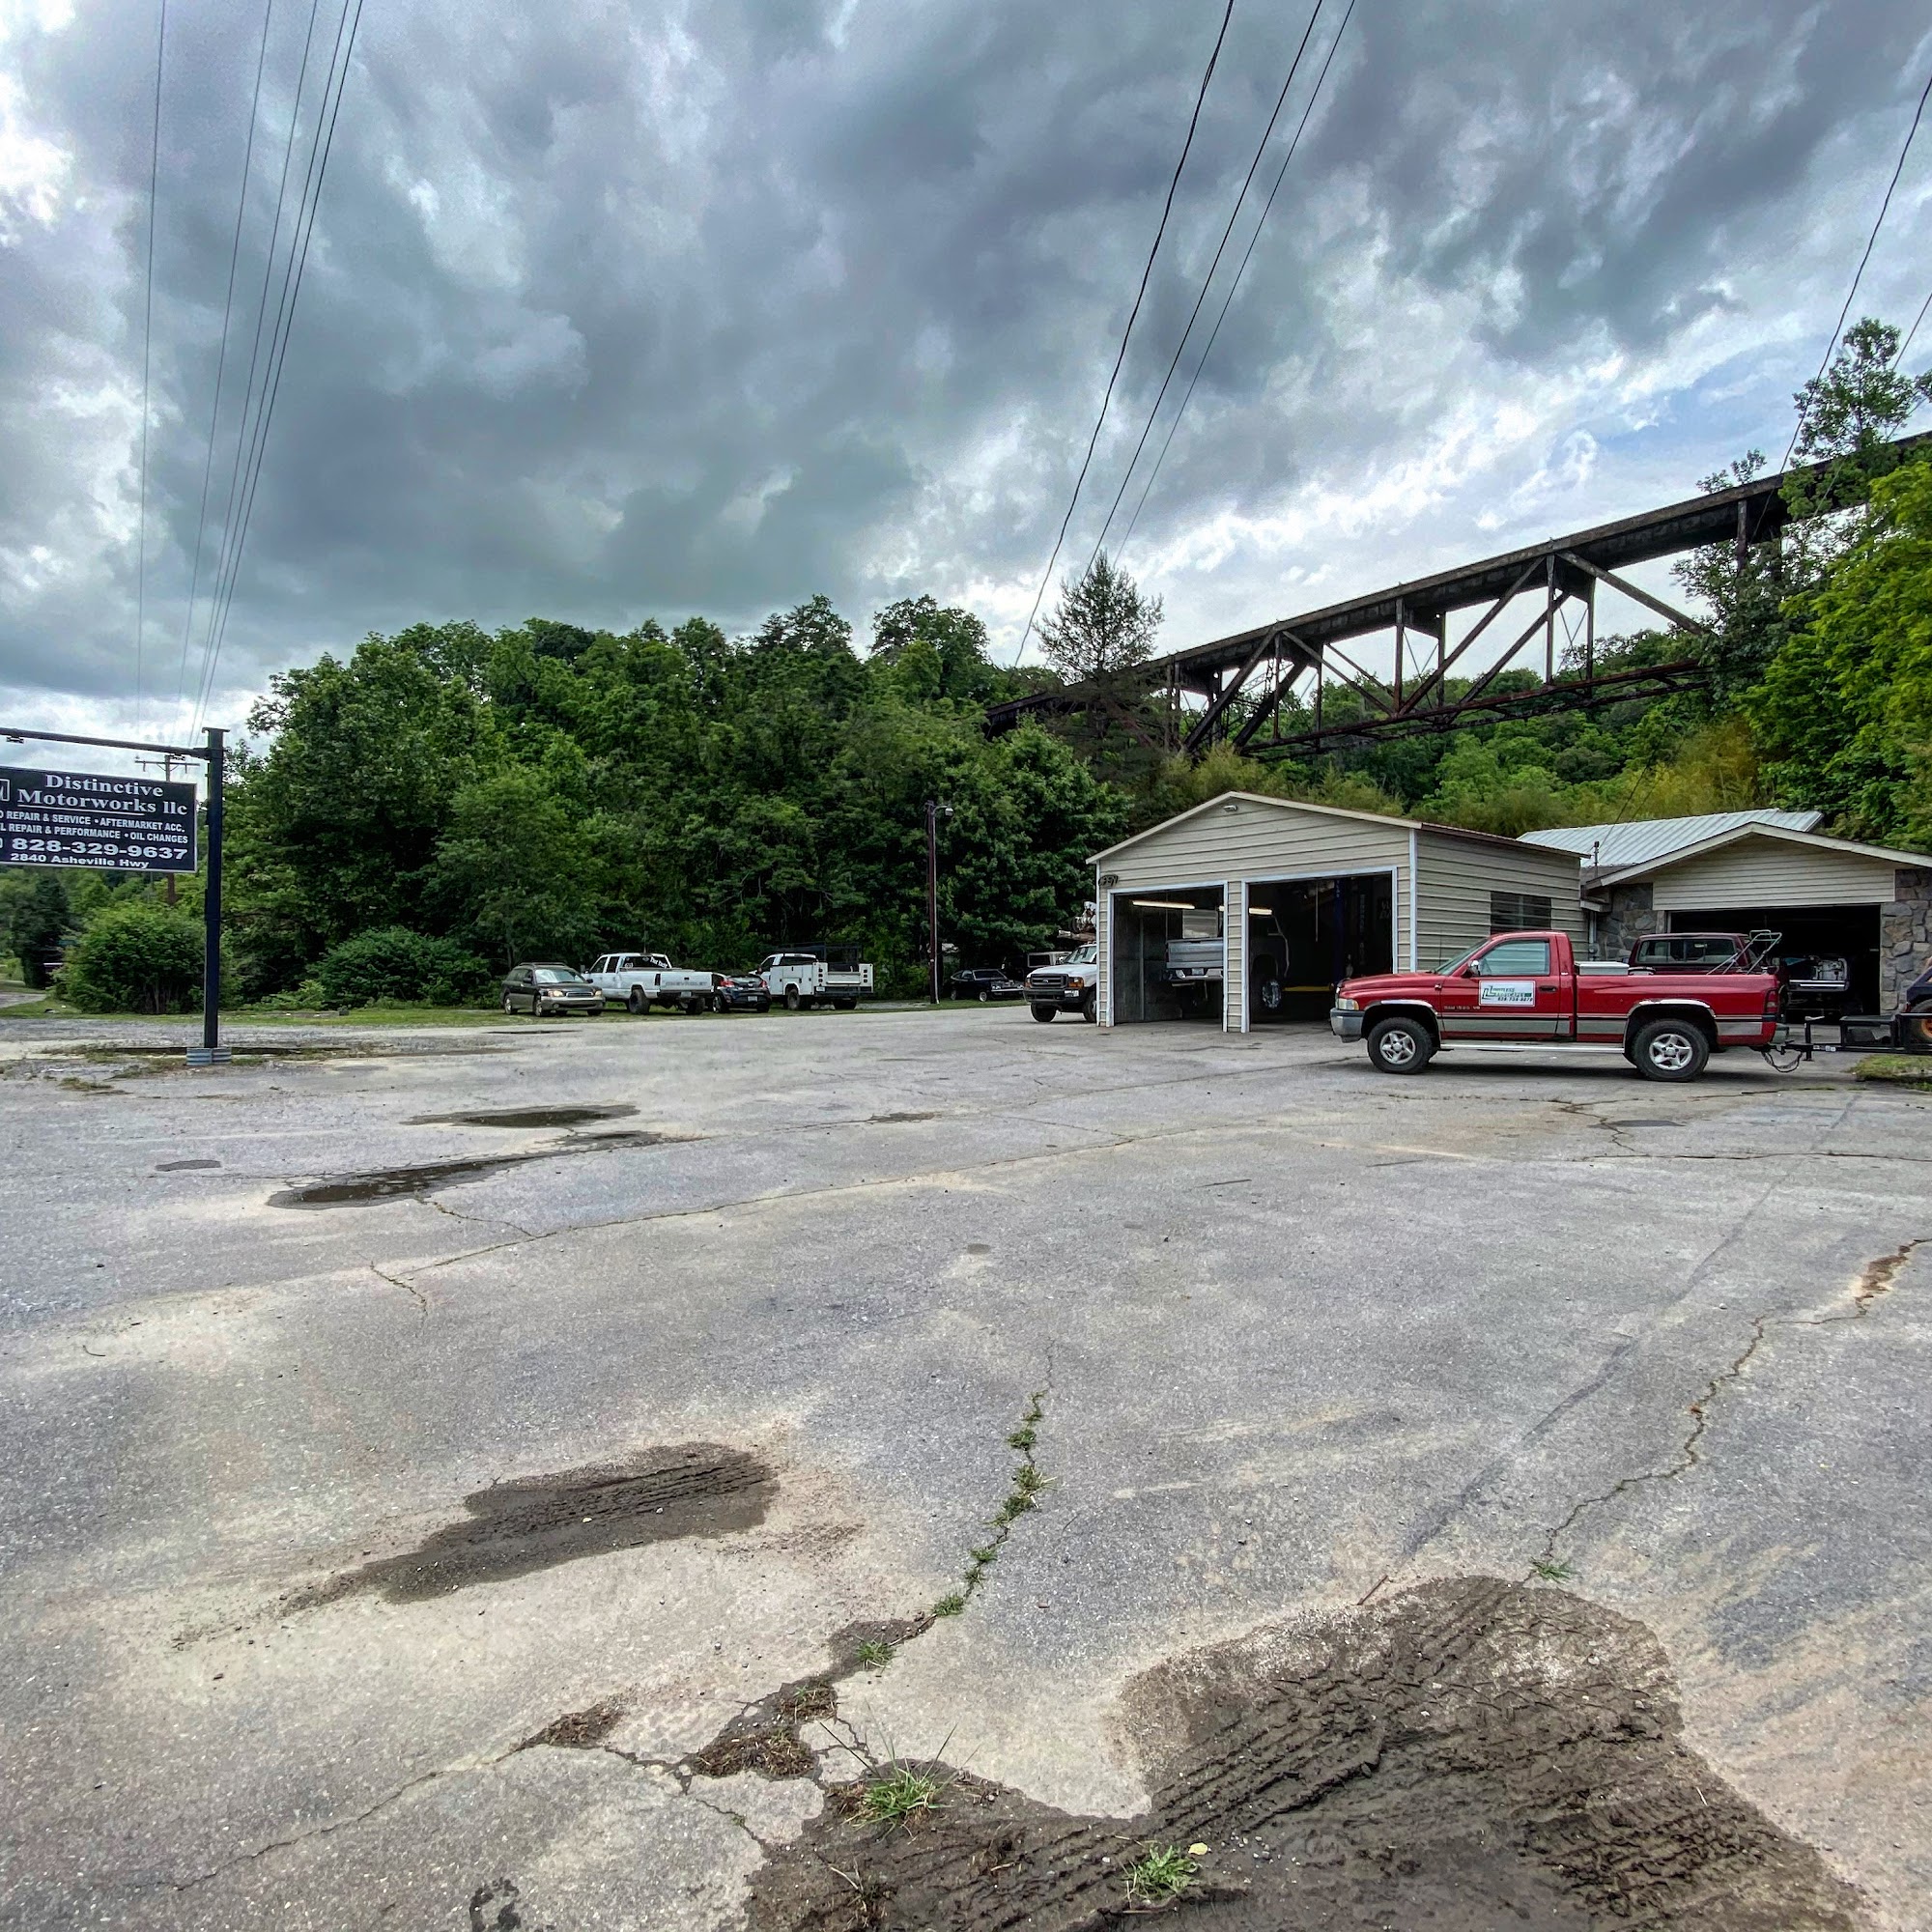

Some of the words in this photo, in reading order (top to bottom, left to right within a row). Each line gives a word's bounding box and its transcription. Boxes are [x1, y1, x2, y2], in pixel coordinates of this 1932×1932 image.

[44, 774, 163, 797] Distinctive
[17, 788, 156, 813] Motorworks
[162, 801, 187, 815] llc
[7, 810, 40, 821] REPAIR
[43, 813, 49, 822] &
[52, 814, 91, 825] SERVICE
[99, 817, 163, 831] AFTERMARKET
[164, 823, 185, 833] ACC.
[9, 823, 43, 834] REPAIR
[44, 826, 51, 835] &
[54, 826, 121, 838] PERFORMANCE
[129, 832, 145, 840] OIL
[147, 833, 188, 843] CHANGES
[12, 838, 188, 860] 828-329-9637
[11, 853, 46, 863] 2840
[51, 855, 115, 867] Asheville
[119, 859, 150, 869] Hwy
